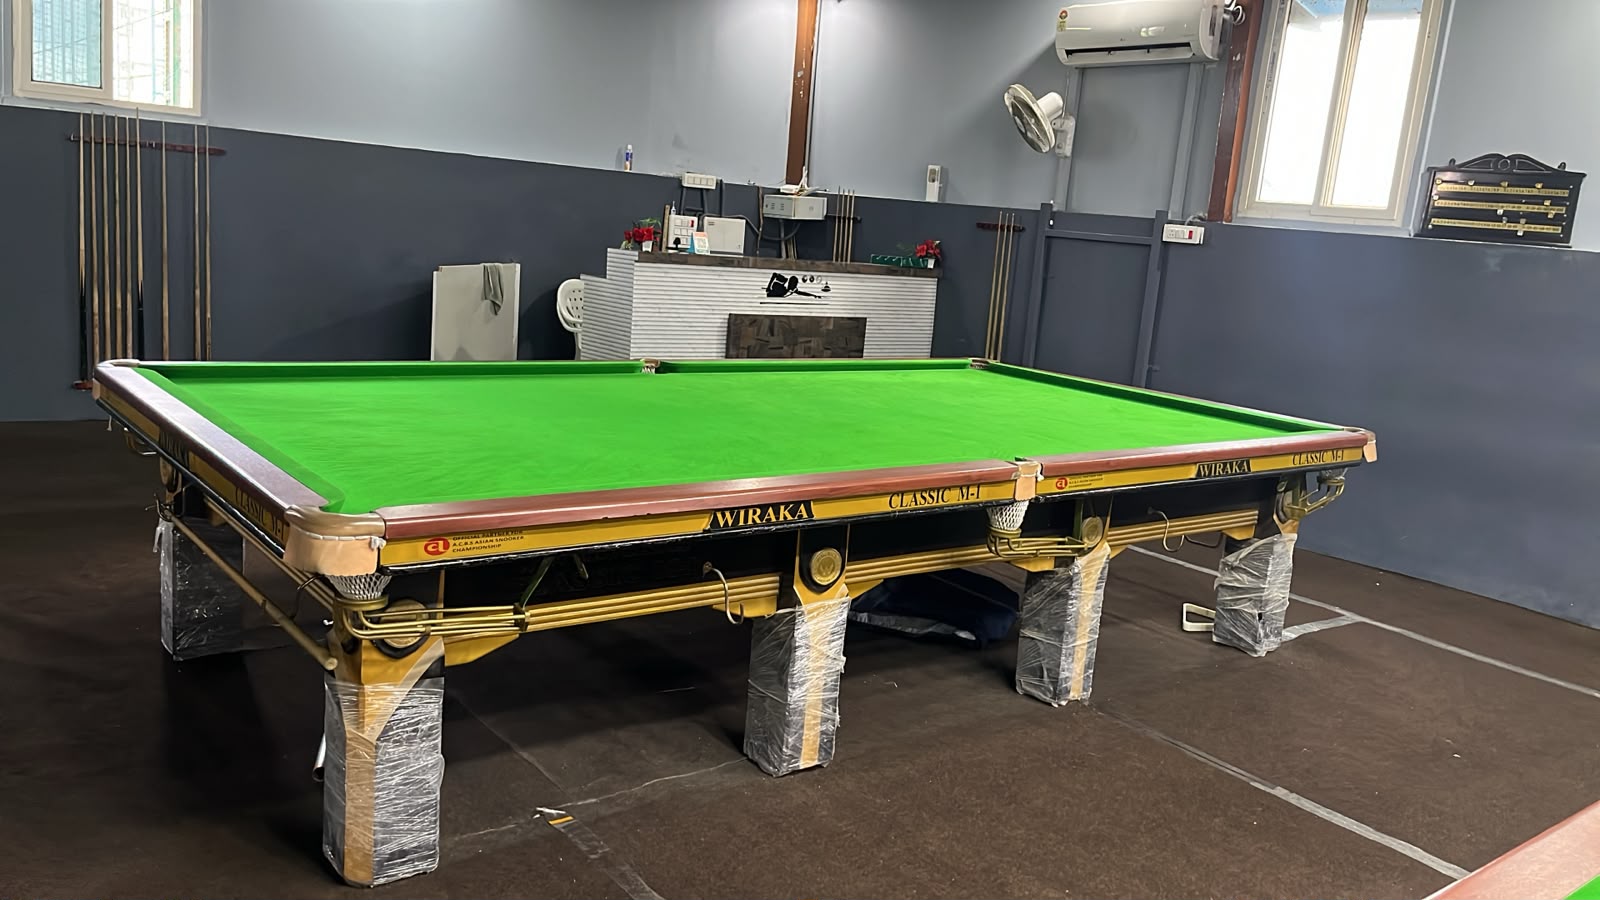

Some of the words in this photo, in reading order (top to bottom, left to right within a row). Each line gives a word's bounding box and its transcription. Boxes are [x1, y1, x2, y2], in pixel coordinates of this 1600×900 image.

[1292, 451, 1328, 466] CLASSIC
[1200, 459, 1248, 478] WIRAKA
[888, 487, 951, 509] CLASSIC
[716, 503, 808, 528] WIRAKA
[452, 544, 501, 552] CHAMPIONSHIP
